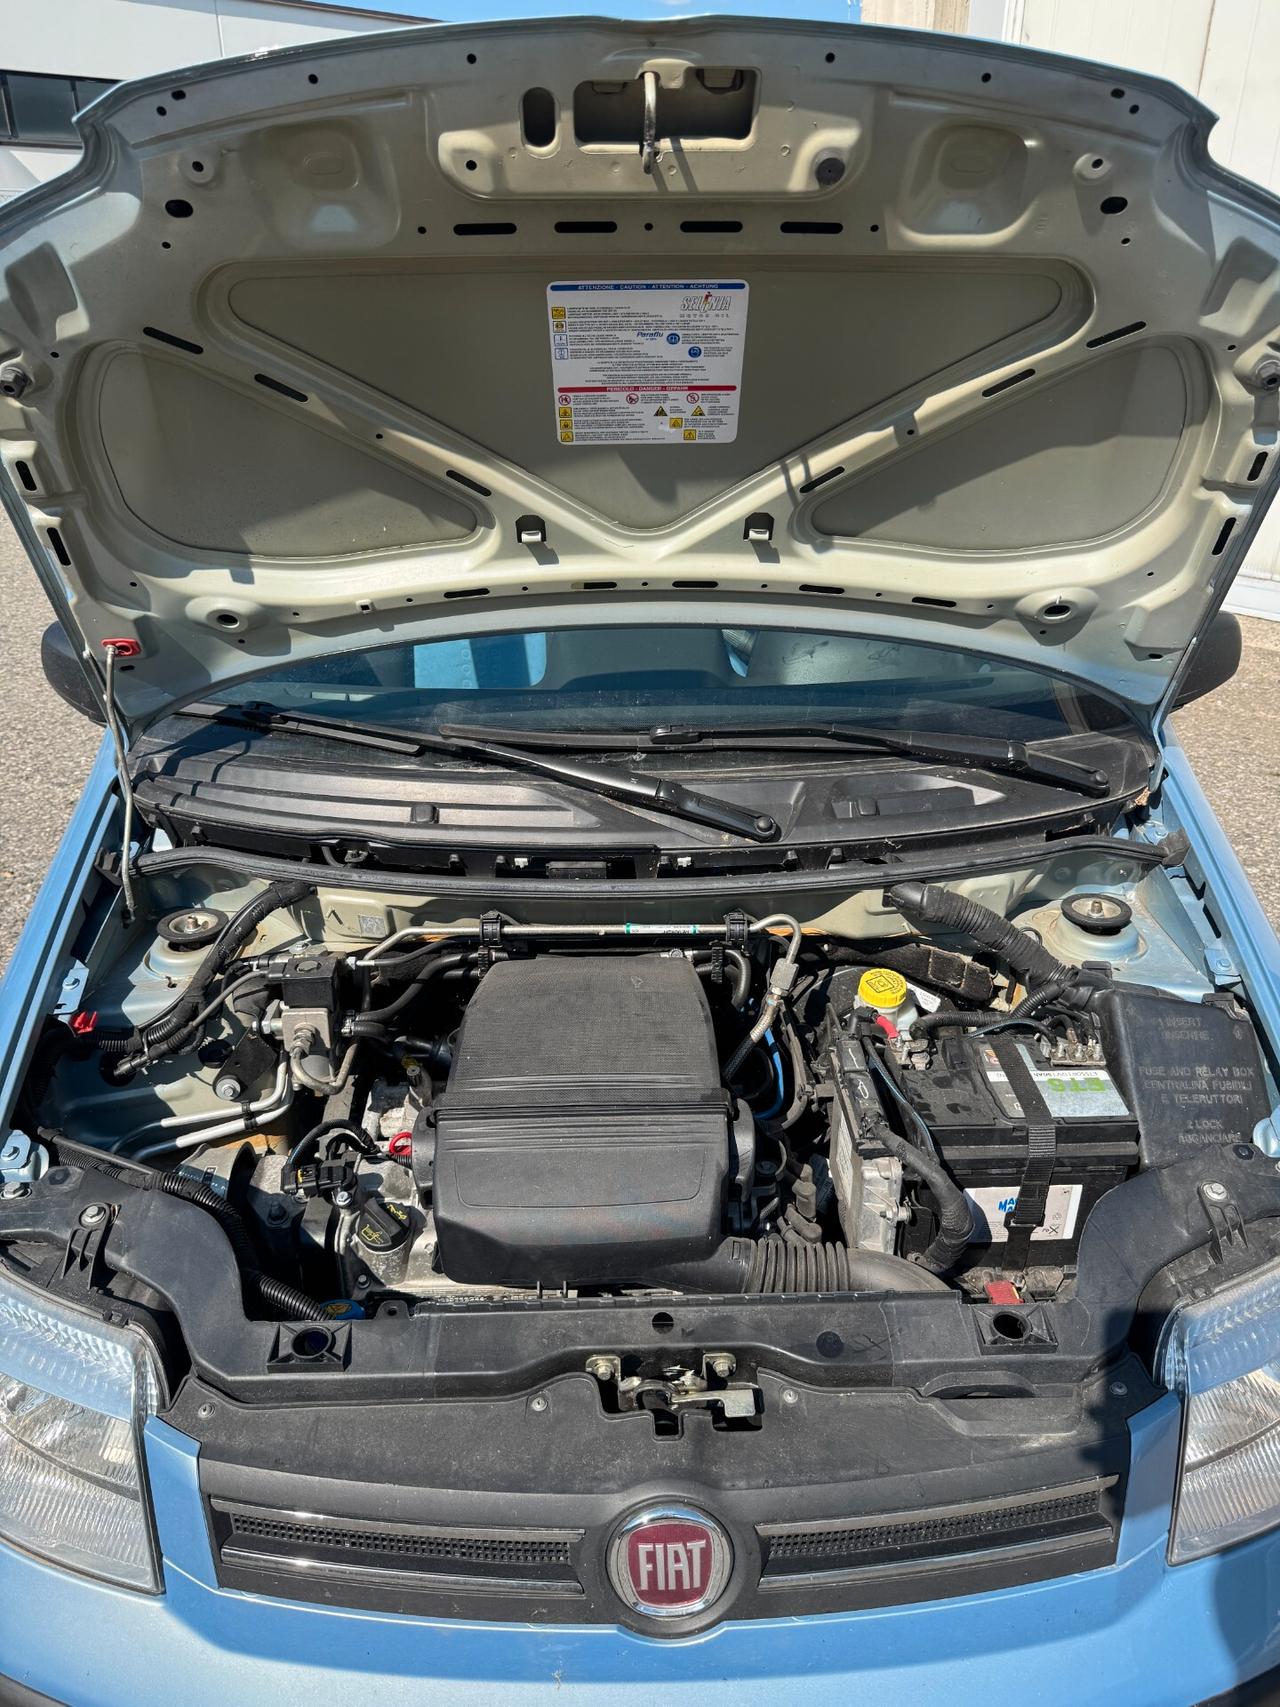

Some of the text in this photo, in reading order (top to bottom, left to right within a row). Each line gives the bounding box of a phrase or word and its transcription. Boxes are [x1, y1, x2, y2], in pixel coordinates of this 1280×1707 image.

[1139, 1066, 1255, 1077] FUSE AND RELAY BOX
[1196, 1119, 1223, 1129] LOCK
[637, 1539, 707, 1591] FIAT
